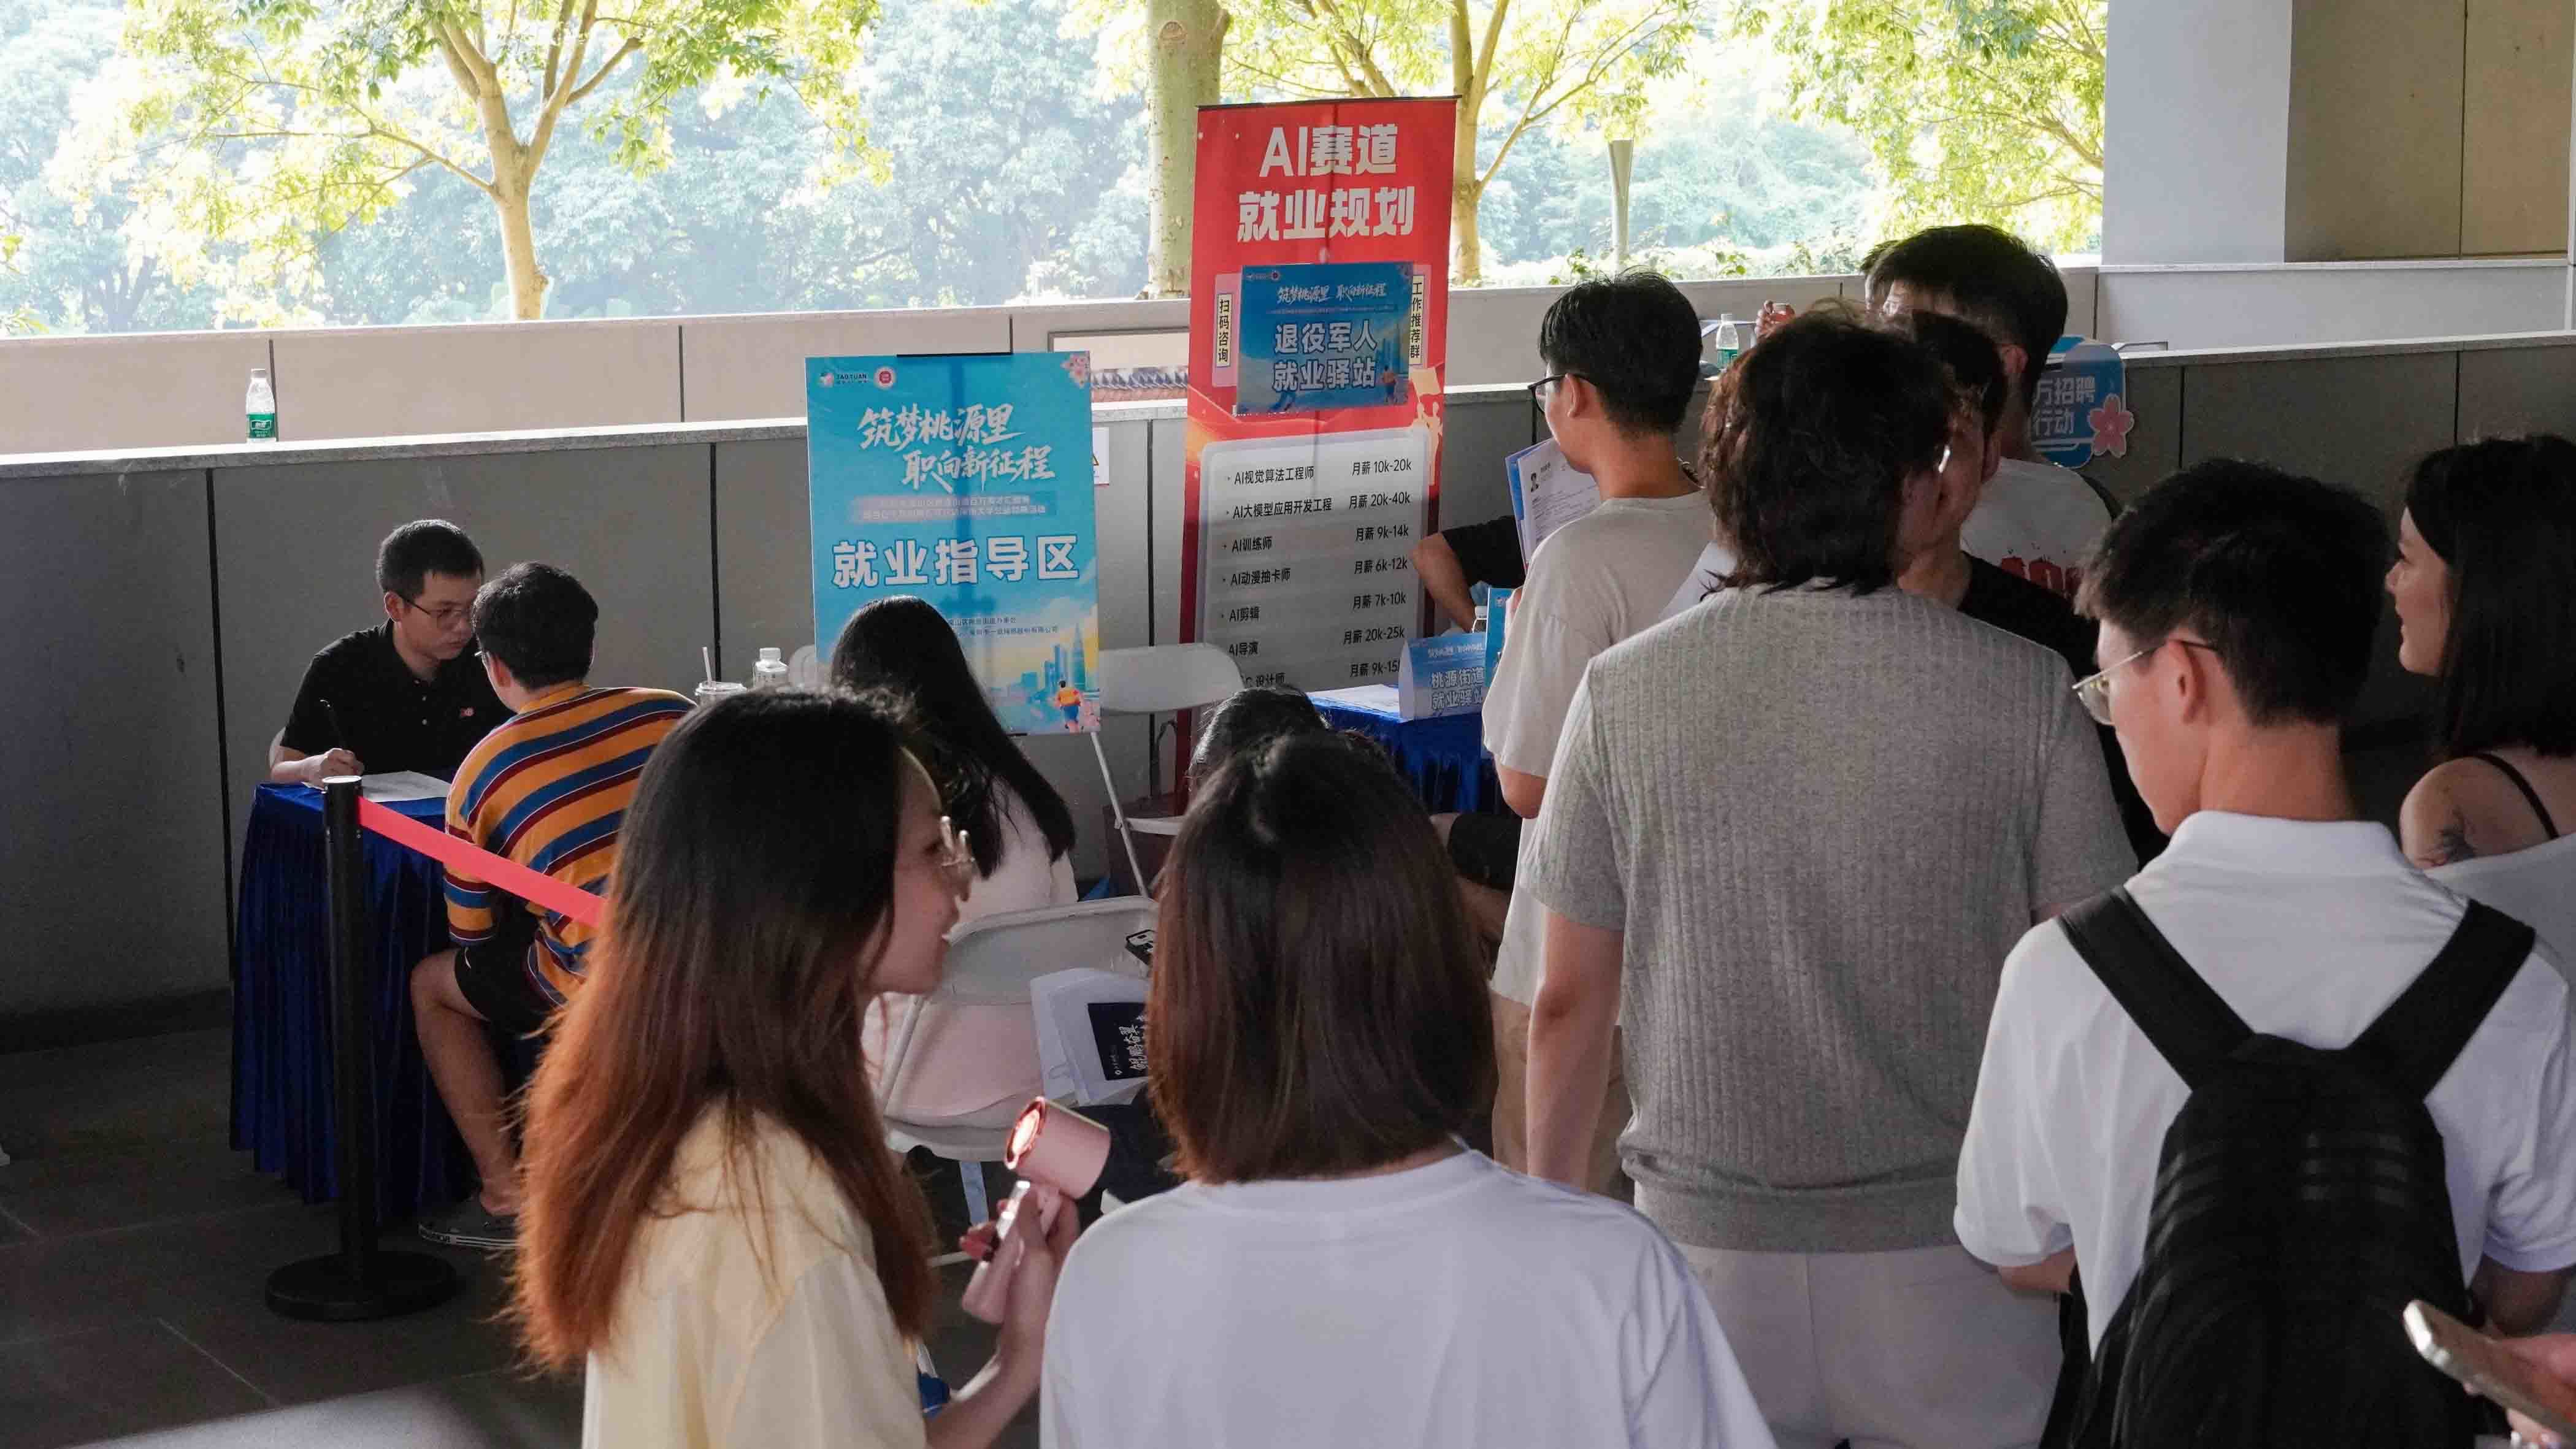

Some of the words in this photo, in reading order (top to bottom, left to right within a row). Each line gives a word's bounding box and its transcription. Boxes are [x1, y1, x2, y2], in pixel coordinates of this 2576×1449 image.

[1259, 124, 1398, 177] AI赛道
[1237, 186, 1415, 243] 就业规划
[1410, 278, 1423, 359] 工作推荐群
[1217, 299, 1230, 363] 扫码咨询
[1274, 319, 1378, 354] 退役军人
[1272, 357, 1376, 392] 就业驿站
[857, 403, 1026, 452] 筑梦桃源里
[2033, 409, 2075, 437] 行动
[901, 445, 1056, 495] 职向新征程
[1234, 465, 1315, 486] AI视觉算法工程师
[1352, 461, 1371, 476] 月薪
[1374, 458, 1412, 473] 10k-20k
[1233, 498, 1332, 519] AI大模型应用开发工程
[1349, 495, 1367, 510] 月薪
[1370, 492, 1411, 507] 20k-40k
[1355, 527, 1374, 542] 月薪
[1376, 526, 1409, 540] 9k-14k
[1232, 536, 1273, 553] AI训练师
[831, 534, 1080, 589] 就业指导区
[1354, 560, 1373, 575] 月薪
[1376, 557, 1408, 572] 6k-12k
[1230, 567, 1291, 586] AI动漫抽卡师
[1352, 595, 1371, 610] 月薪
[1374, 592, 1407, 606] 7k-10k
[1229, 606, 1260, 622] AI剪辑
[1343, 630, 1362, 644] 月薪
[1365, 627, 1405, 641] 20k-25k
[1229, 641, 1259, 657] AI导演
[1255, 672, 1286, 687] 设计师
[1350, 663, 1368, 678] 月薪
